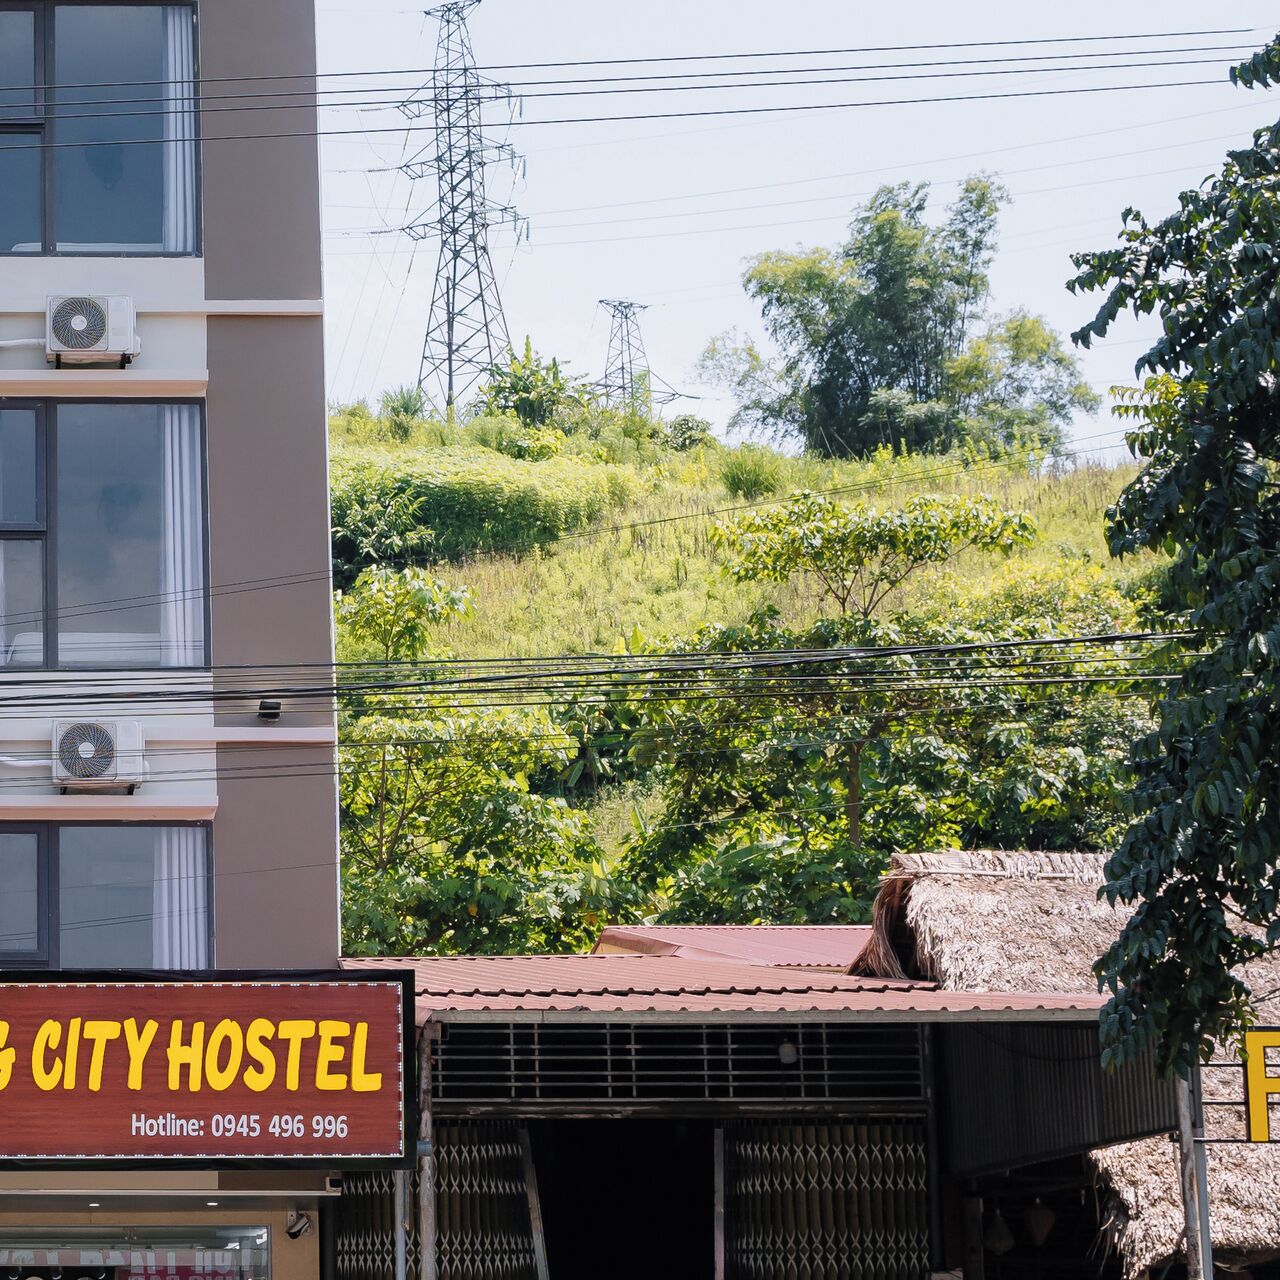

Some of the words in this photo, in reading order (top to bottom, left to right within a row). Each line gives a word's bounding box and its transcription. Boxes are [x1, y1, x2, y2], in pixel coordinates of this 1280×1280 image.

[31, 1016, 159, 1091] CITY
[166, 1018, 382, 1092] HOSTEL
[130, 1113, 205, 1137] Hotline:
[211, 1114, 261, 1138] 0945
[268, 1114, 305, 1138] 496
[312, 1115, 348, 1139] 996
